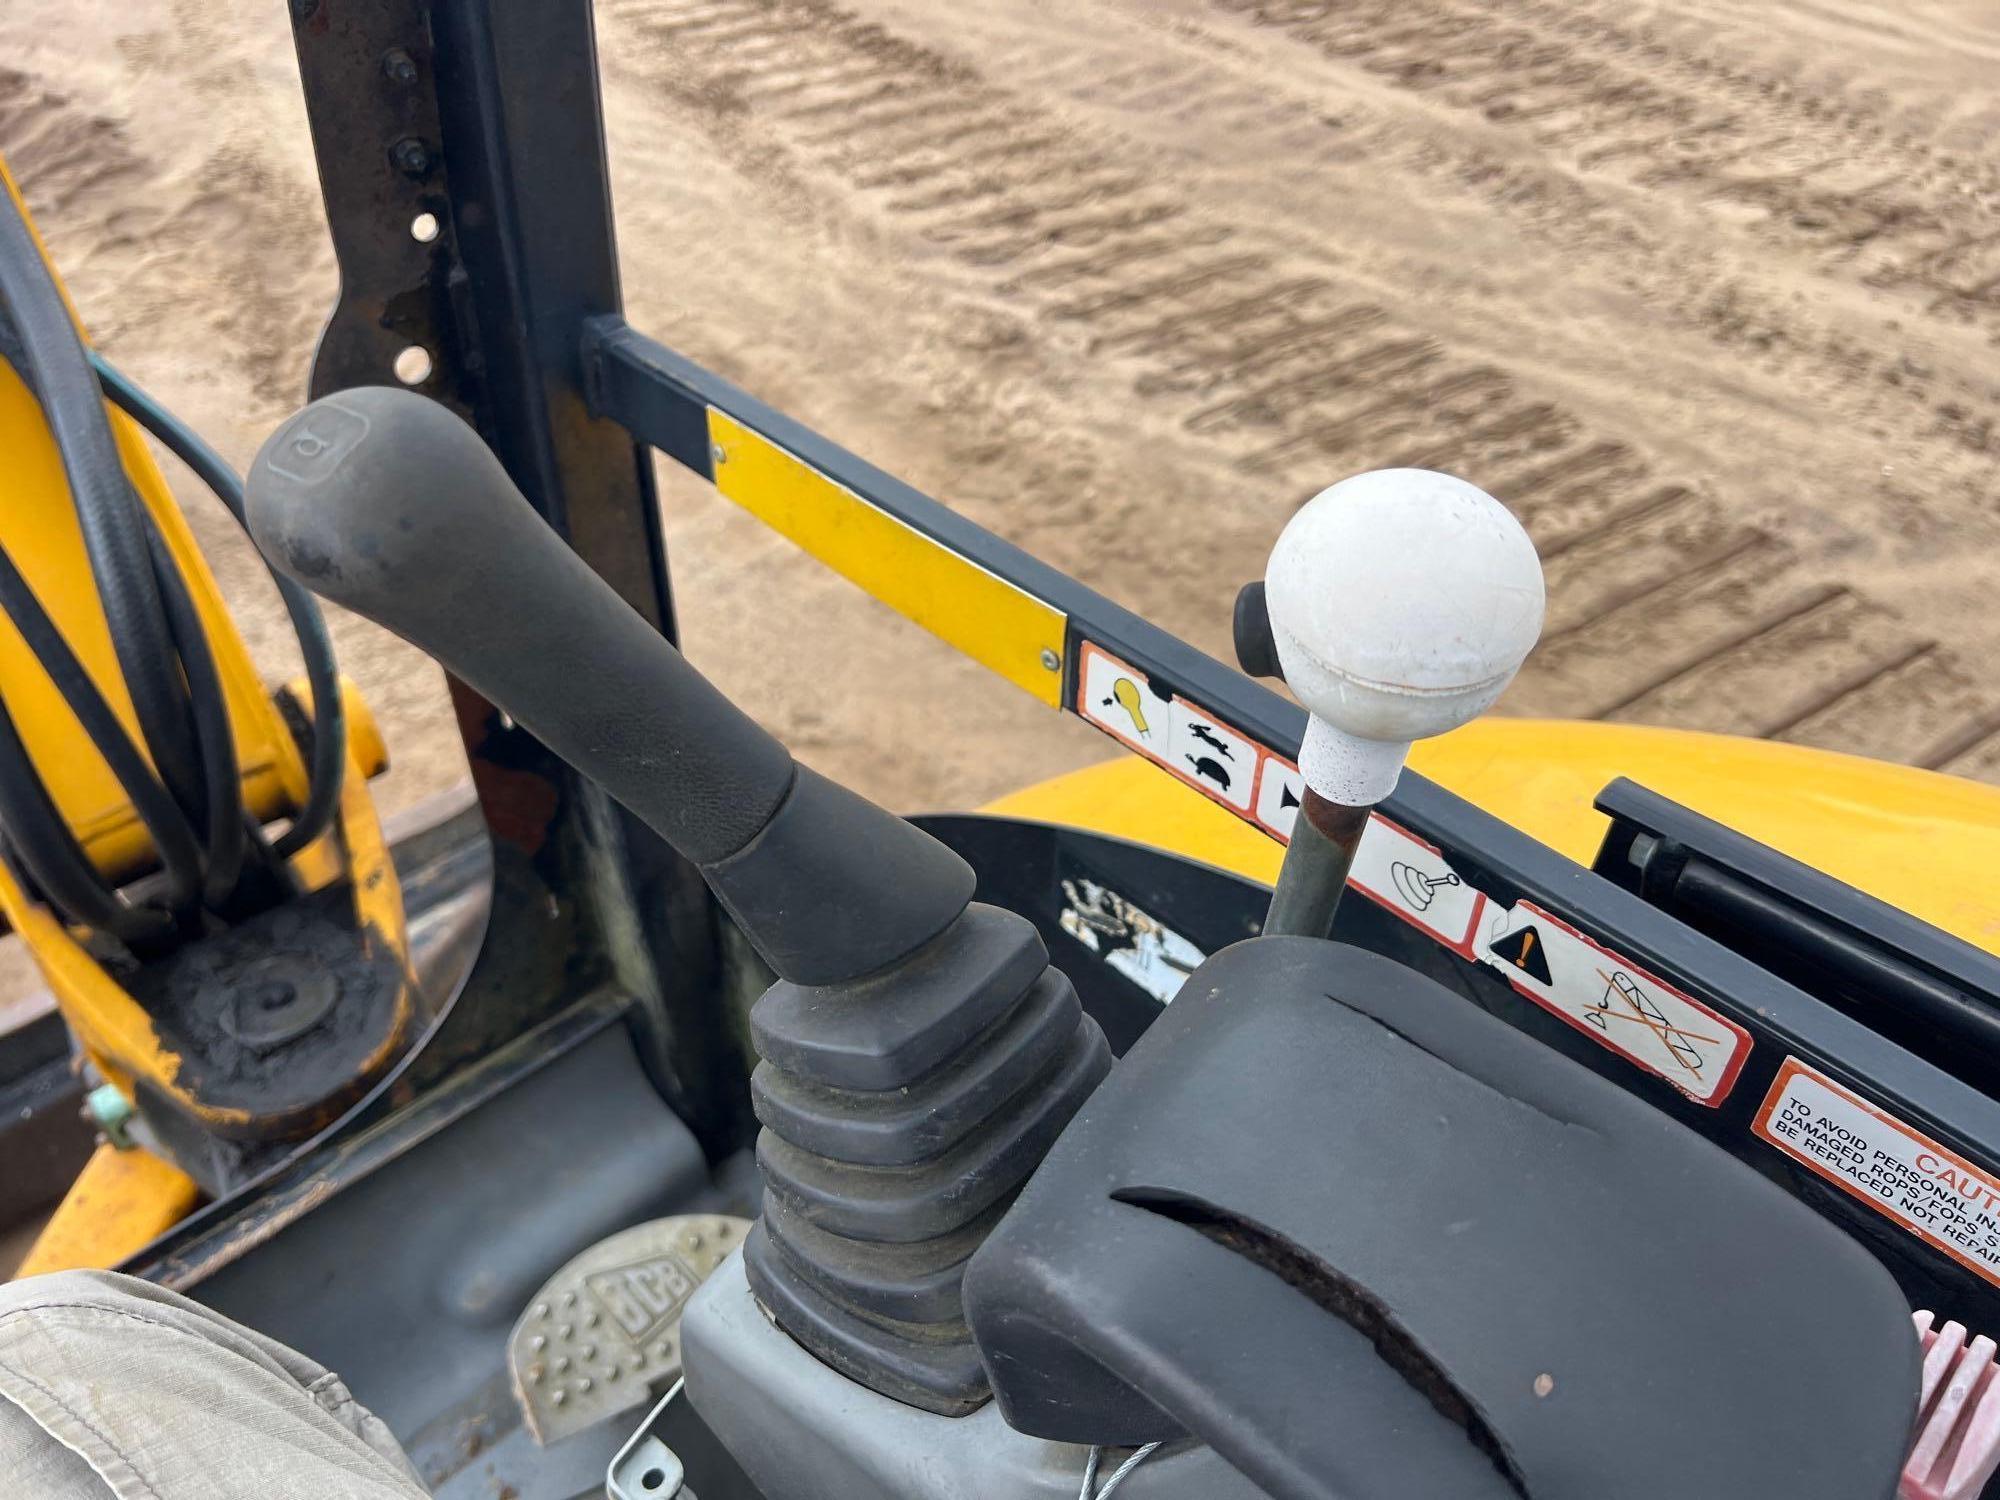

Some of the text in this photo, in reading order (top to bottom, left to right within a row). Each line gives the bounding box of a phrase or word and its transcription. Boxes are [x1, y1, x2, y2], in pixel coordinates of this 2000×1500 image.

[1775, 1120, 1799, 1140] BE
[1803, 1138, 1894, 1198] REPLACED
[1899, 1197, 1939, 1224] NOT
[1781, 1109, 1865, 1164] DAMAGED
[1870, 1163, 1979, 1235] ROPS/FOPS
[1790, 1096, 1811, 1117] TO
[1816, 1117, 1868, 1151] AVOID
[1873, 1150, 1968, 1215] PERSONAL
[1916, 1154, 2000, 1217] CAUT
[594, 1260, 689, 1334] JCB
